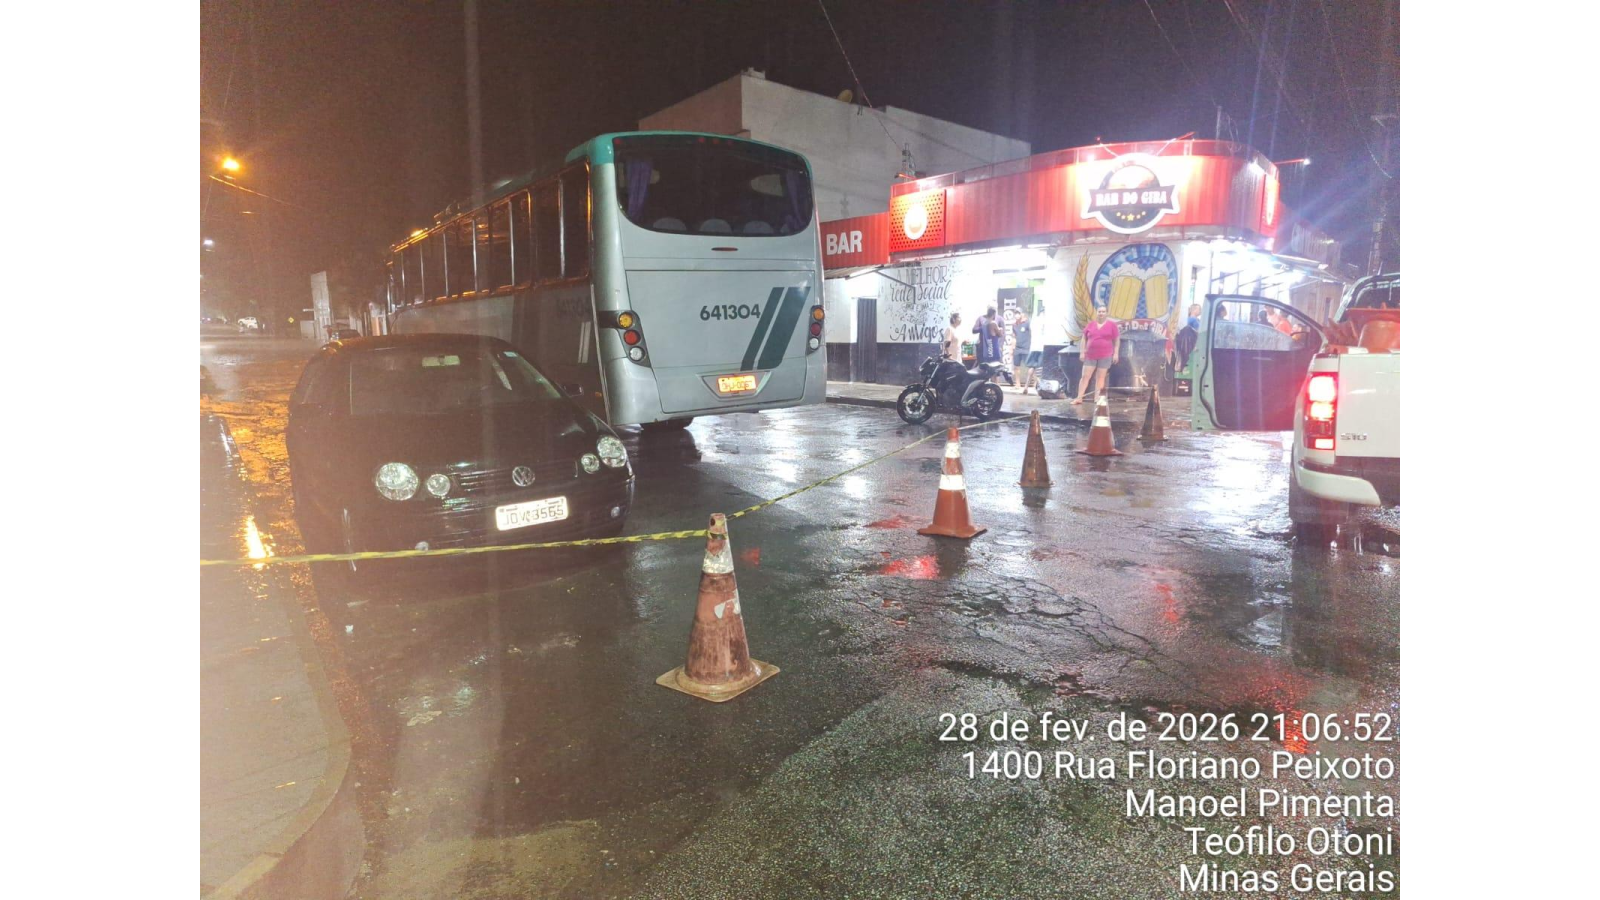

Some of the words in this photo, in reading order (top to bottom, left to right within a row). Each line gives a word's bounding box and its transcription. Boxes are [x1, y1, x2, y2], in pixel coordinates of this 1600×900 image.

[1122, 190, 1139, 205] DO
[826, 230, 862, 256] BAR
[699, 303, 761, 321] 641304
[889, 323, 945, 344] Amigos
